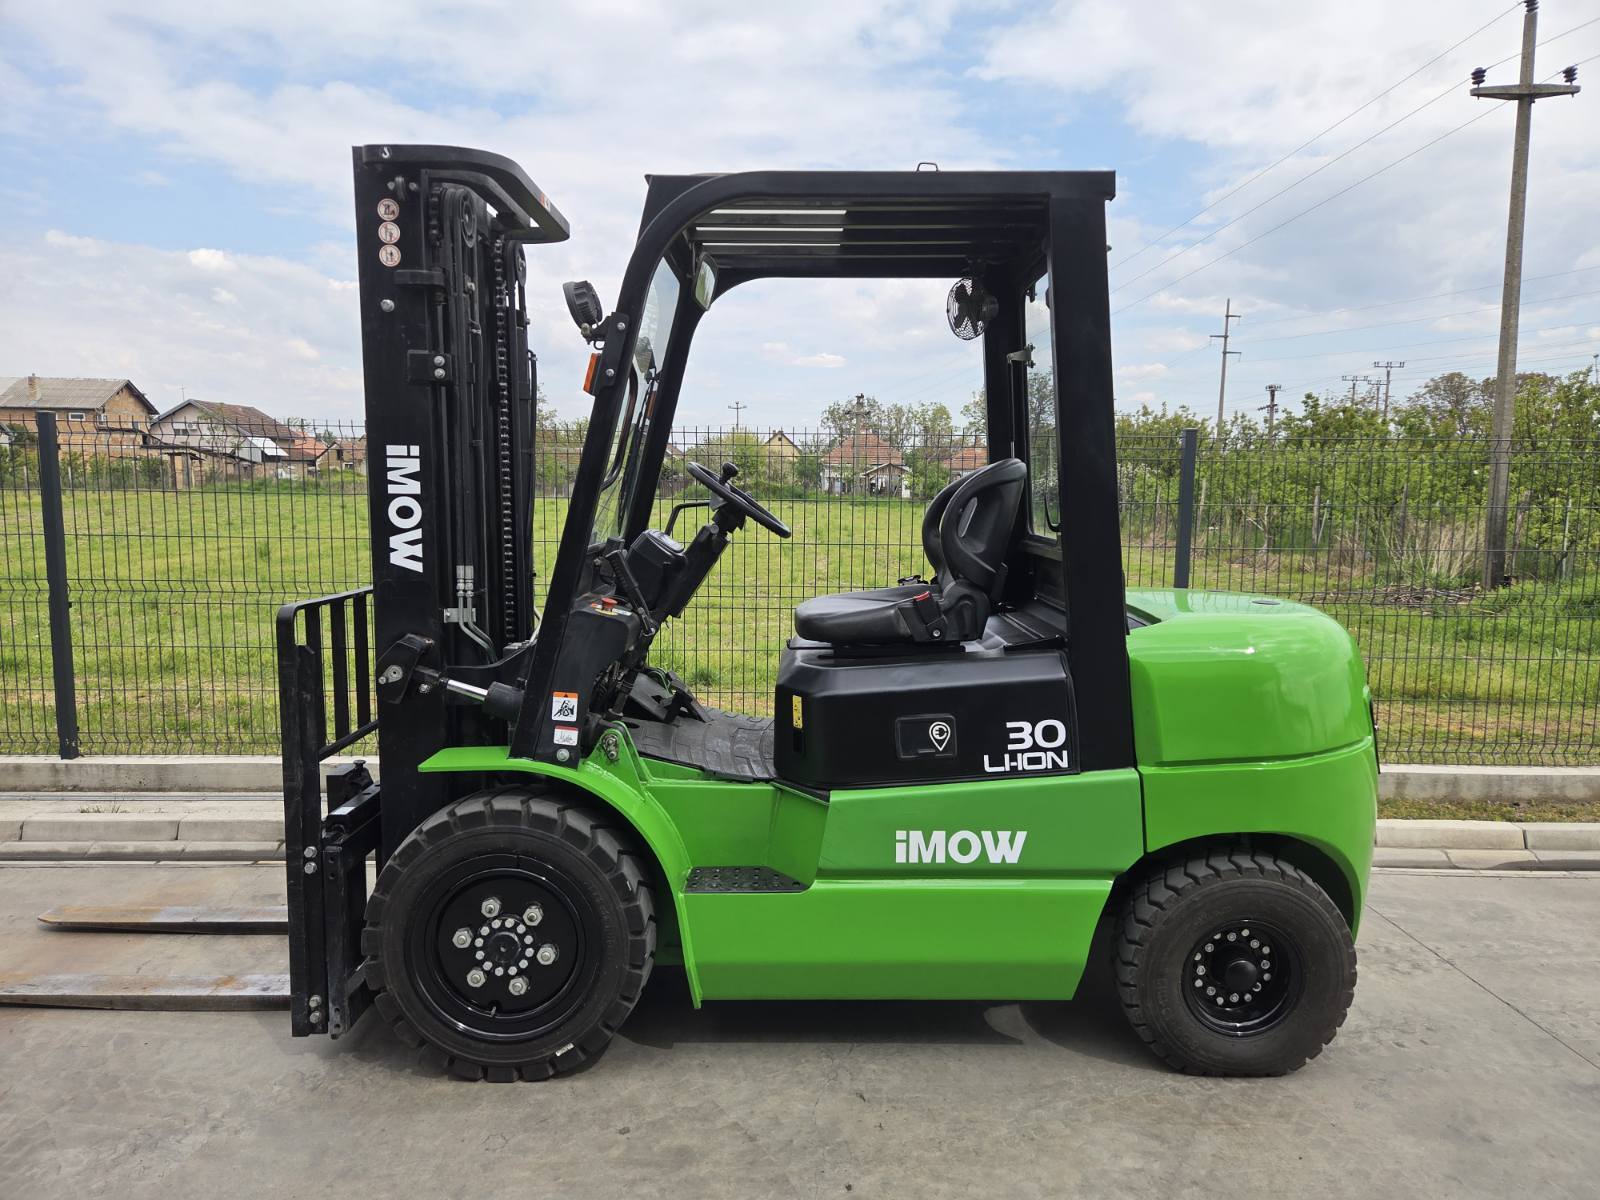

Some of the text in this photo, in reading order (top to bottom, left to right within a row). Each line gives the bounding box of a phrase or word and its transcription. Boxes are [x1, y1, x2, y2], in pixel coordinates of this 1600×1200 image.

[386, 444, 424, 573] iMOW
[1006, 719, 1067, 751] 30
[895, 830, 1027, 864] iMOW
